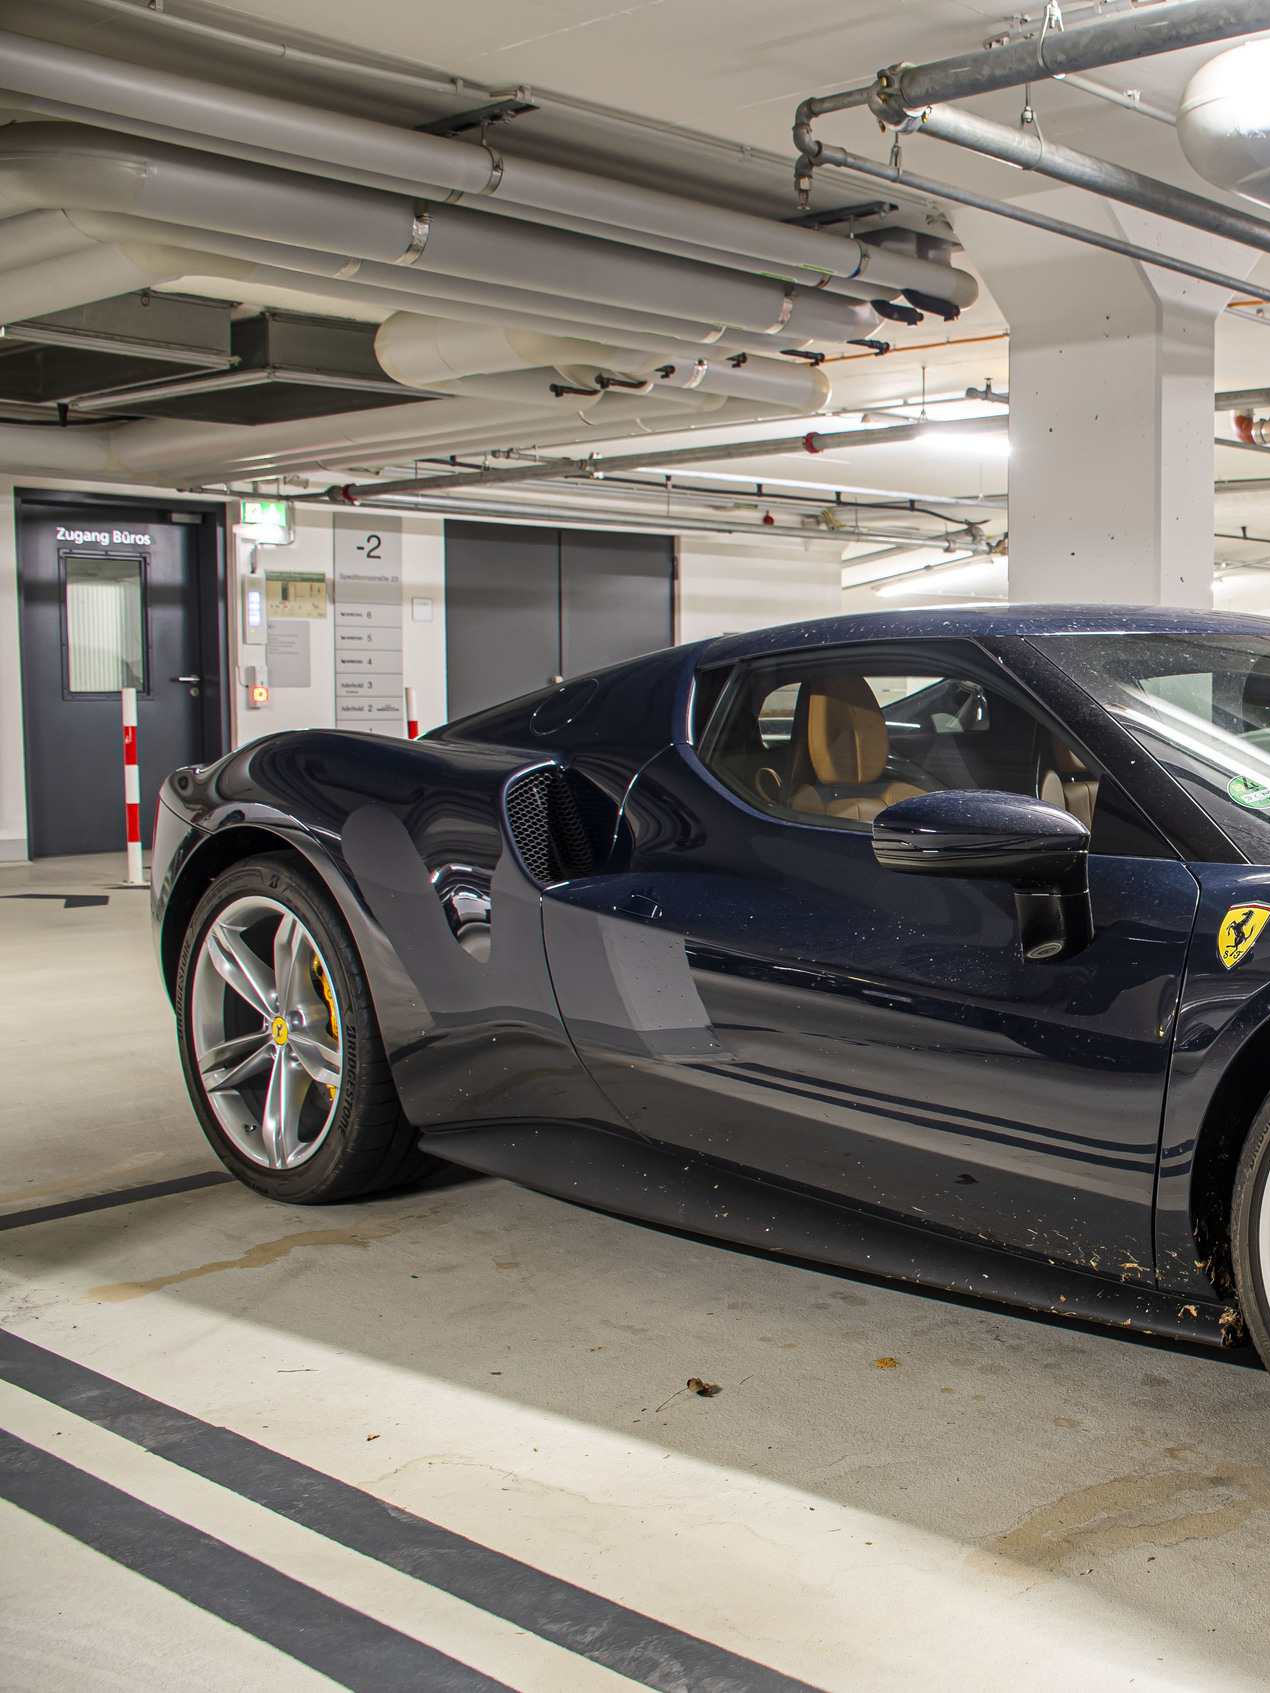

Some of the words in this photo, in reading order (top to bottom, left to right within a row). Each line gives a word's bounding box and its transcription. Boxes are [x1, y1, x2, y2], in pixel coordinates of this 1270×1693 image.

[56, 527, 110, 546] Zugang
[112, 530, 152, 546] Büros
[356, 534, 382, 559] -2
[366, 611, 372, 619] 6
[366, 634, 372, 642] 5
[366, 681, 373, 689] 3
[367, 704, 373, 712] 2
[1223, 950, 1229, 959] S
[338, 1023, 357, 1137] BRIDGESTONE
